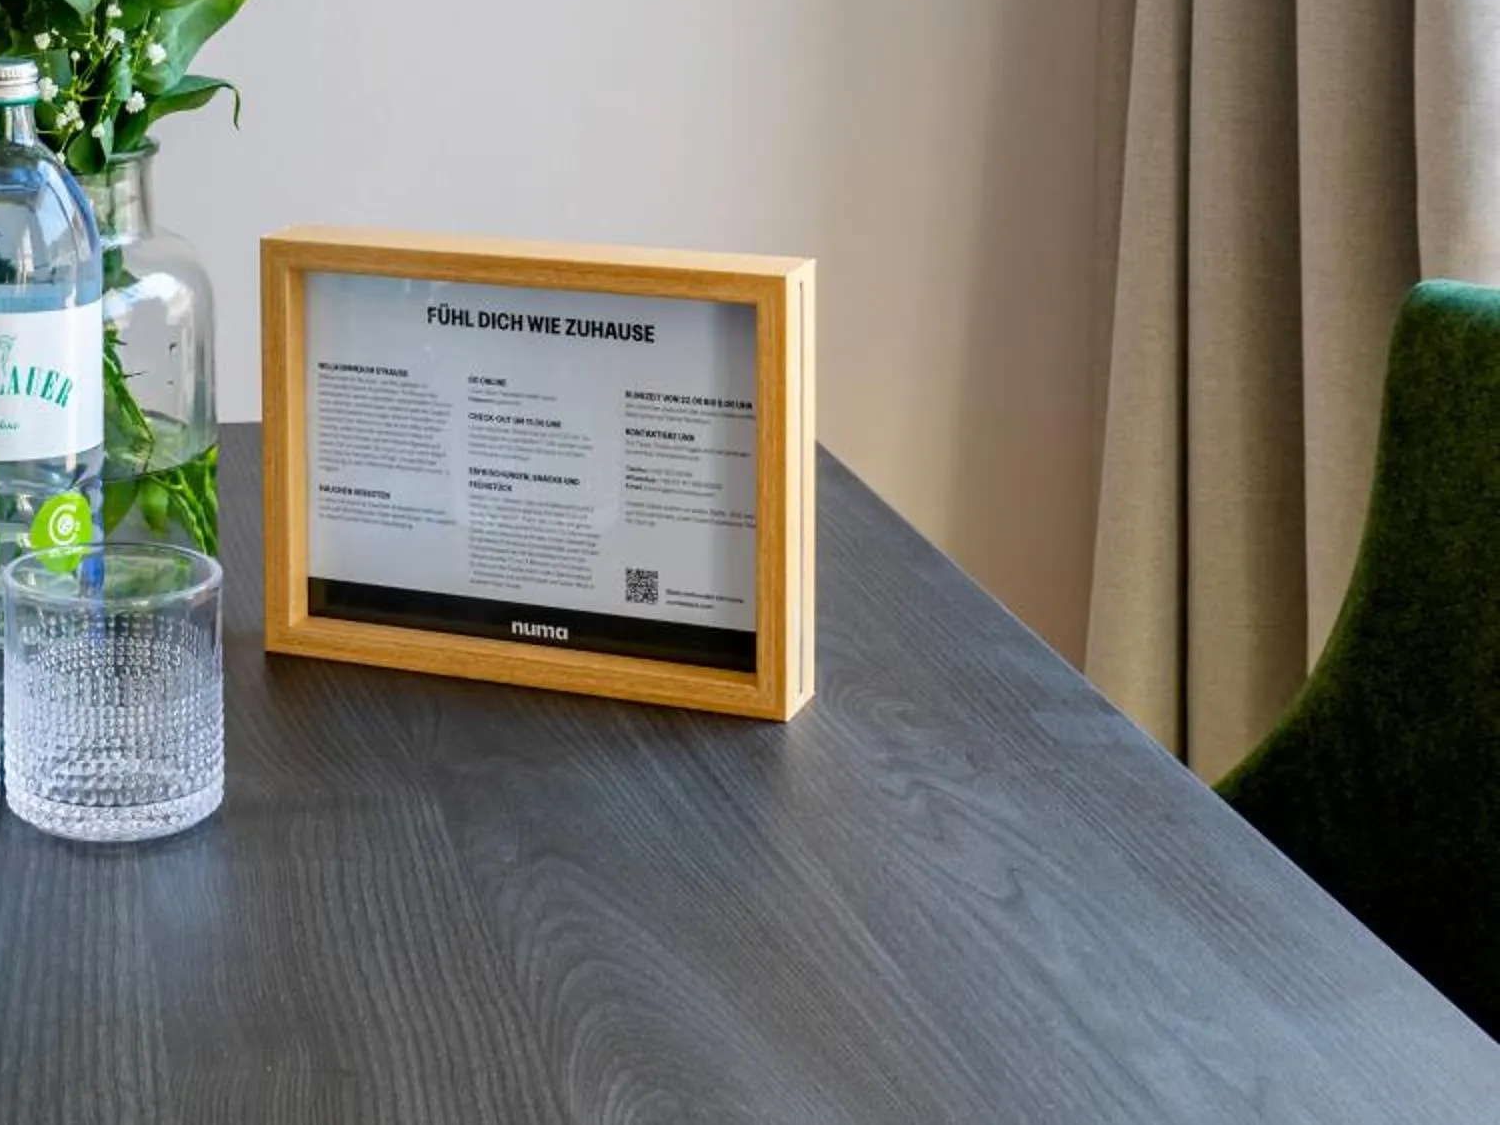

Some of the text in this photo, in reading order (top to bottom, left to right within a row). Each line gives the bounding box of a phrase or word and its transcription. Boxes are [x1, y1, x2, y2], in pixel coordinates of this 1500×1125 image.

[427, 303, 656, 343] FÜHL DICH WIE ZUHAUSE
[511, 620, 569, 641] numa
